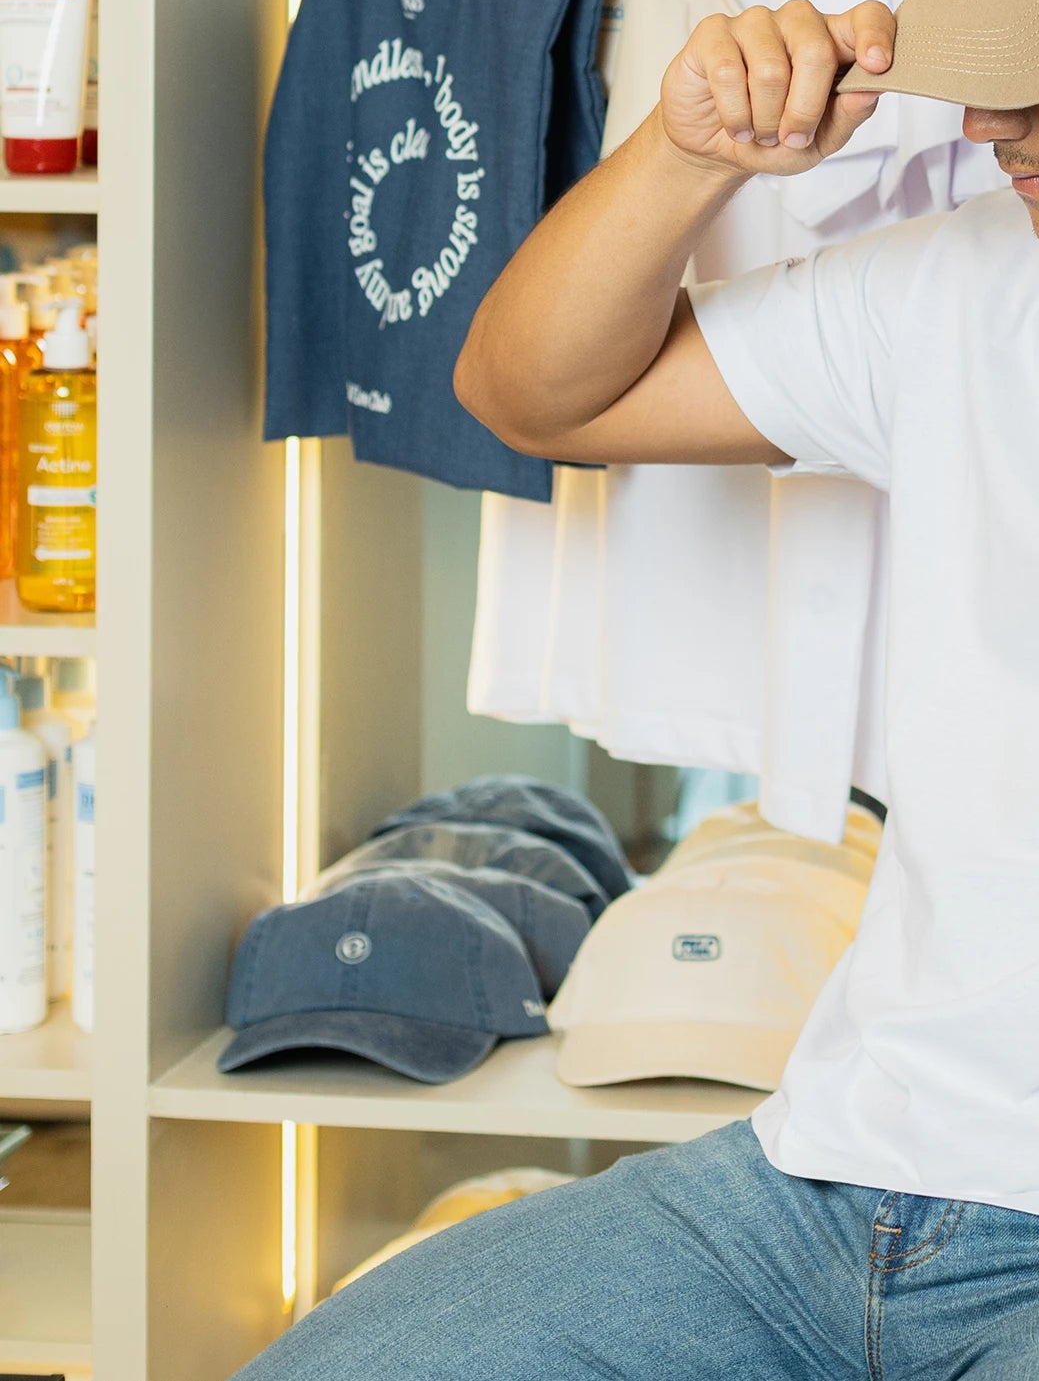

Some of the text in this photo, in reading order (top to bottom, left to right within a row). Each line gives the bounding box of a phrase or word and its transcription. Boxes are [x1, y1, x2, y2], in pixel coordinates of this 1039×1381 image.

[434, 73, 479, 161] body
[357, 147, 390, 185] is
[457, 167, 485, 200] is
[348, 176, 377, 257] goal
[354, 258, 391, 312] my
[411, 204, 478, 317] strong
